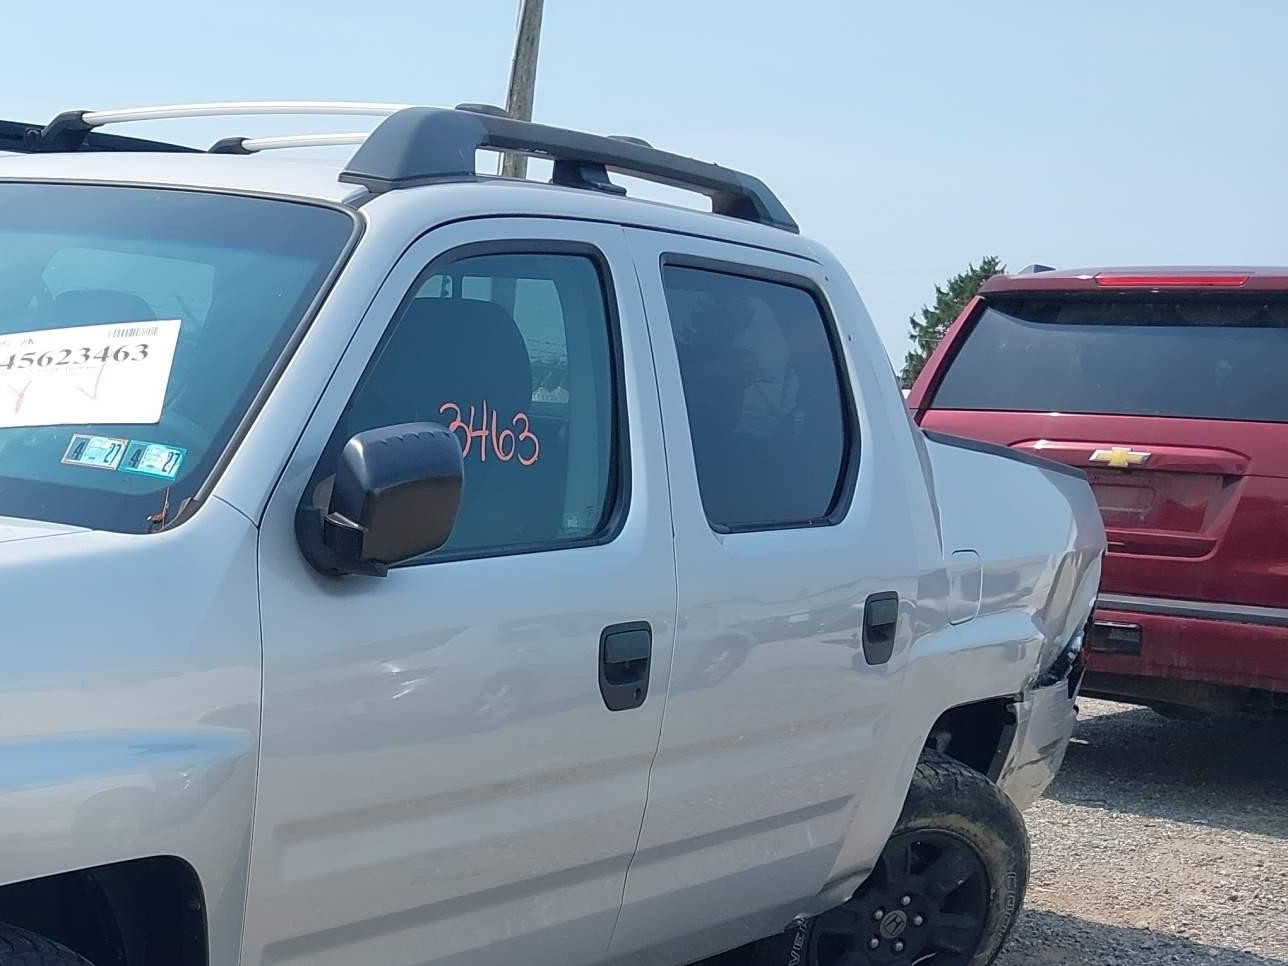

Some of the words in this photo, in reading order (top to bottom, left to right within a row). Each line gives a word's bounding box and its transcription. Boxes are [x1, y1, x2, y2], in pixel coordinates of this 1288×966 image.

[439, 399, 540, 466] 3463
[71, 440, 86, 461] 4
[103, 442, 123, 466] 27
[161, 451, 181, 475] 27
